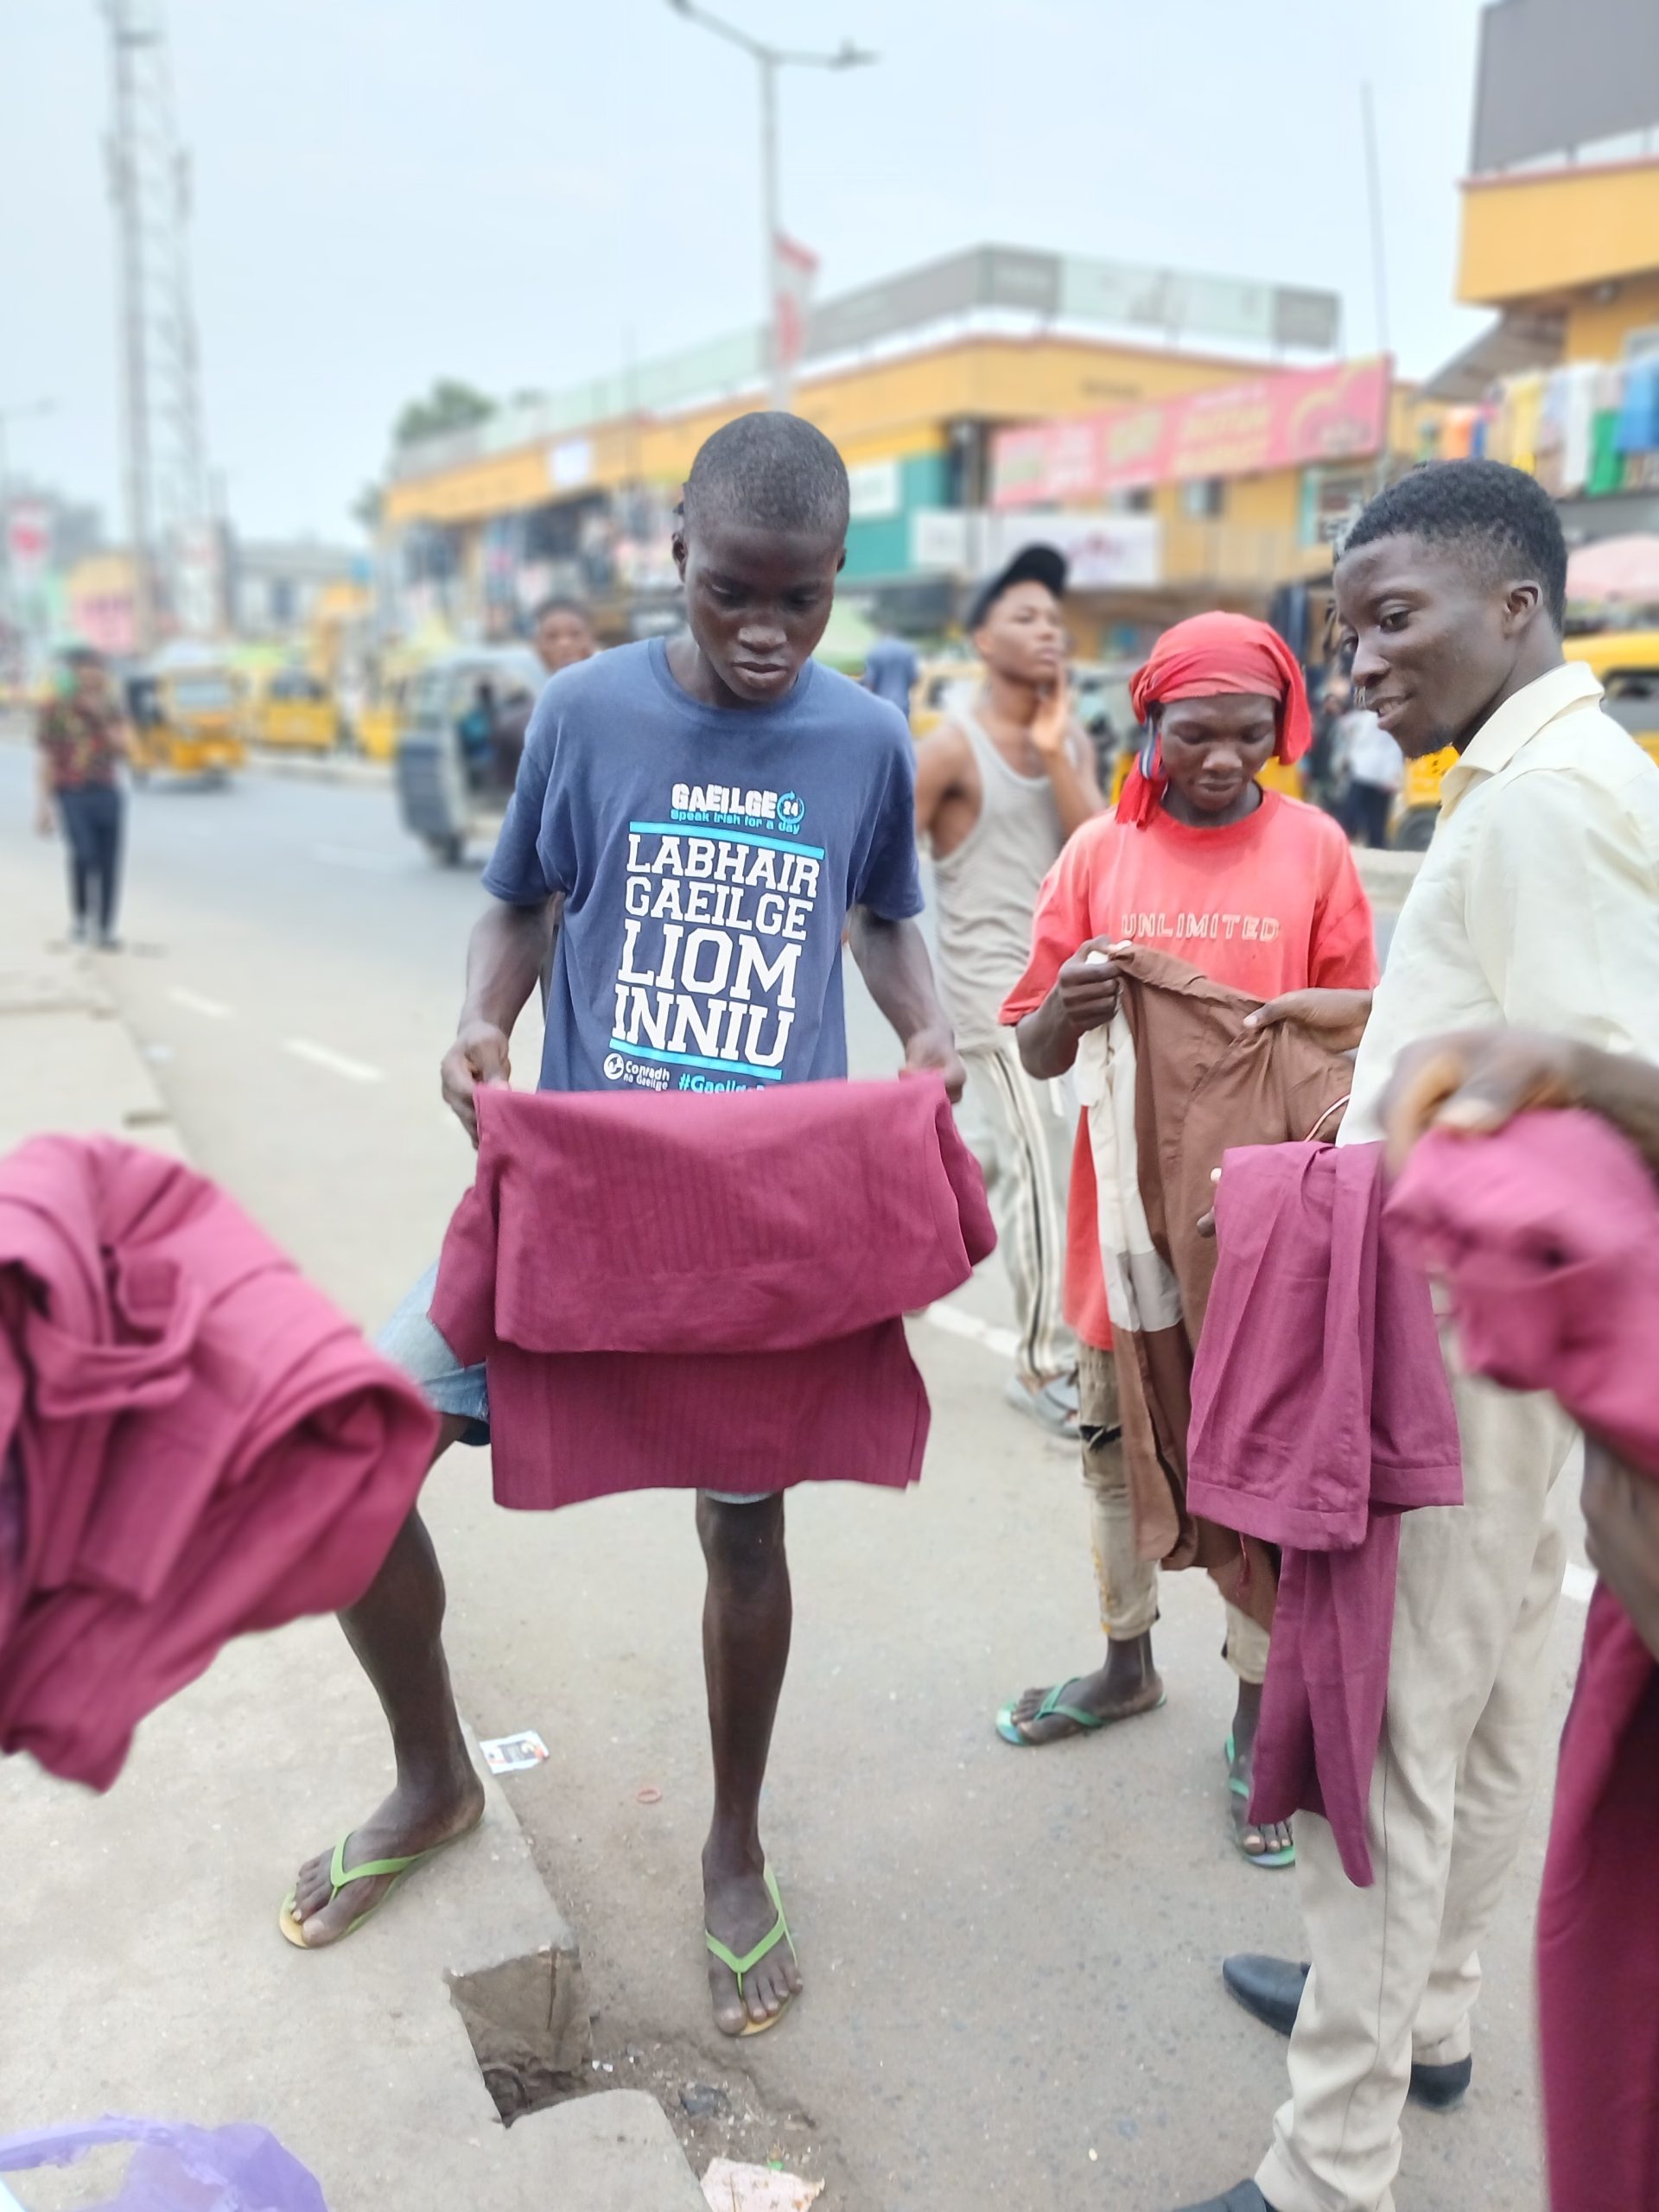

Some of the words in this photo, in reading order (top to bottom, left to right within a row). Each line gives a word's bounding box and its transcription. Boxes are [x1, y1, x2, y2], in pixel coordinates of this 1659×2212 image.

[671, 783, 778, 819] GAEILGE
[783, 800, 798, 817] 24
[745, 816, 762, 828] for
[766, 820, 774, 830] a
[779, 818, 800, 835] day
[626, 834, 820, 898] LABHAIR
[626, 876, 814, 940] GAEILGE
[1121, 912, 1280, 942] UNLIMITED
[618, 918, 803, 1008] LIOM
[612, 983, 795, 1067] INNIU
[623, 1072, 634, 1083] na
[636, 1074, 669, 1092] Gaeilge
[626, 1060, 671, 1081] Conradh
